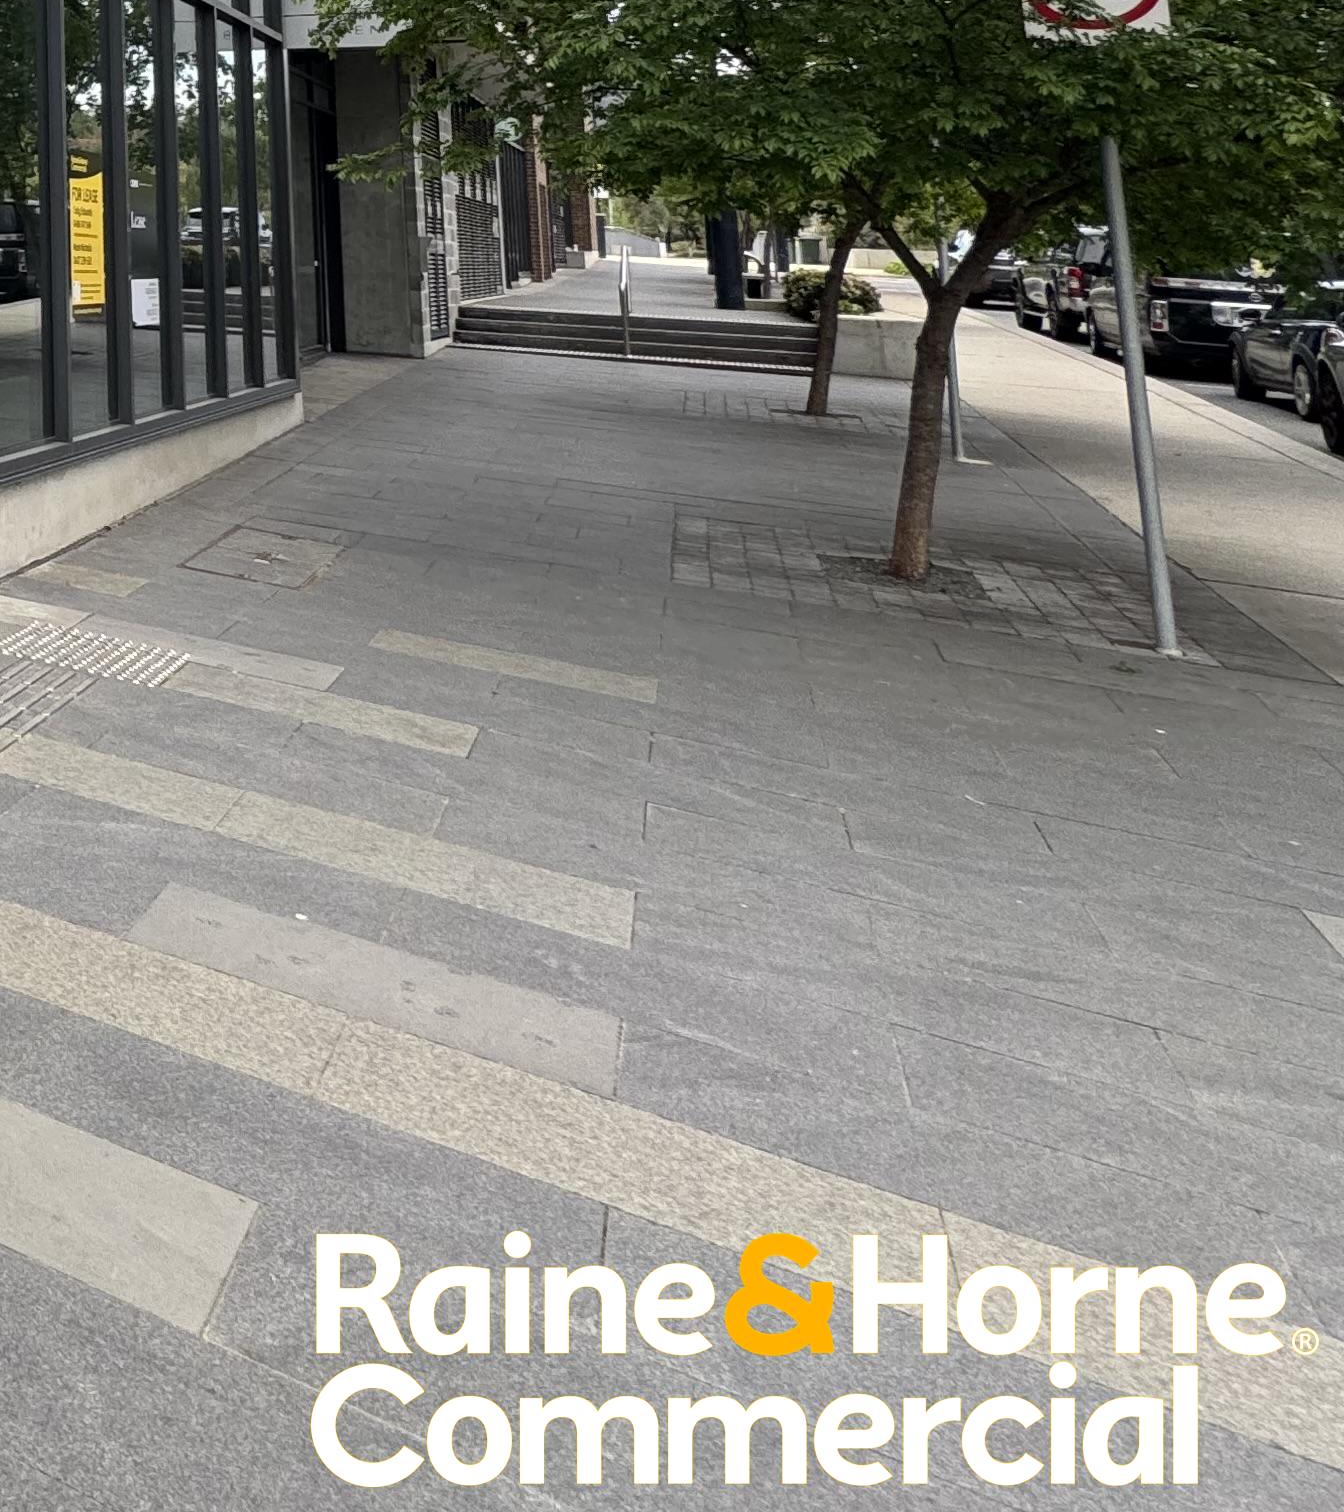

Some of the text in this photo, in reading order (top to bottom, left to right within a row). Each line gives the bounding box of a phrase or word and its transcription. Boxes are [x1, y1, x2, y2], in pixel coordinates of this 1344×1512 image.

[72, 187, 99, 204] FOR LEASE
[130, 210, 147, 228] Lease
